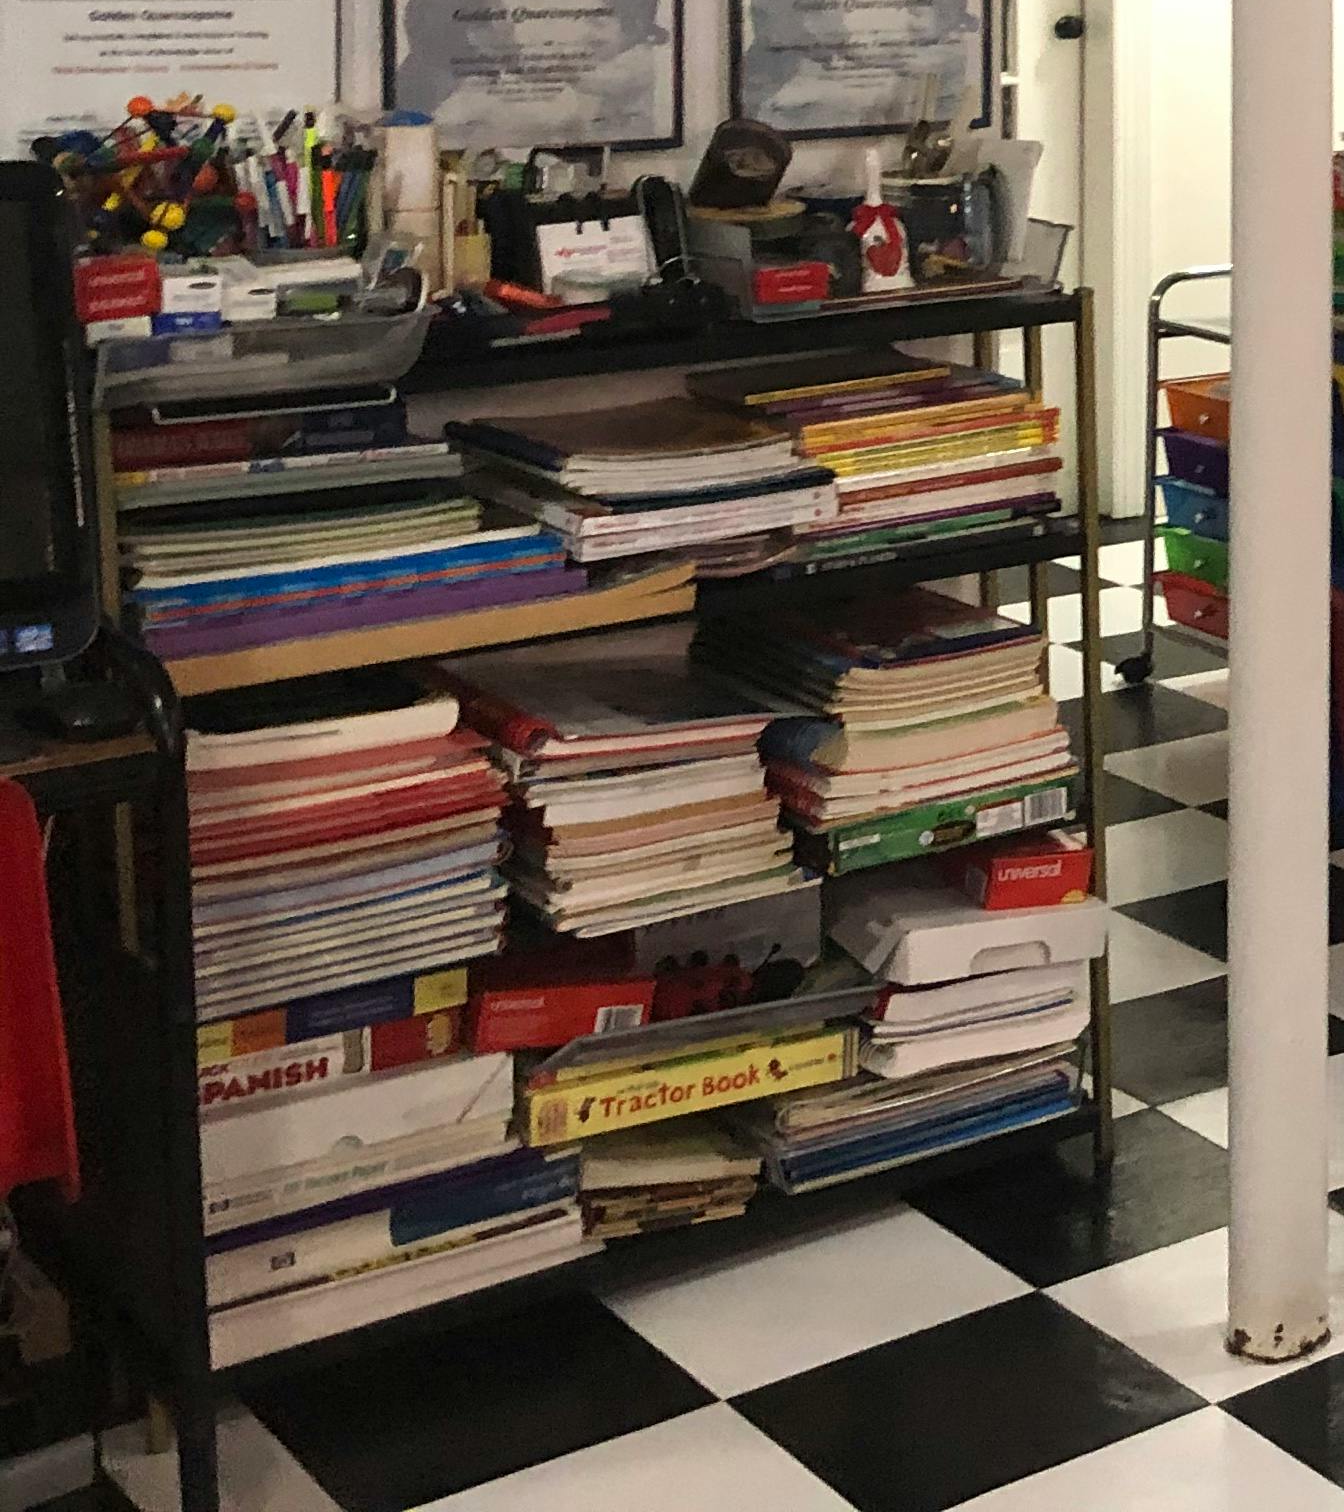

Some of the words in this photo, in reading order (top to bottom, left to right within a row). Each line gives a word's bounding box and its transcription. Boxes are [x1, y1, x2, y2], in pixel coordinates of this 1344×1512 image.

[203, 1056, 329, 1106] PANISH
[599, 1079, 696, 1118] Tractor
[701, 1064, 761, 1097] Book
